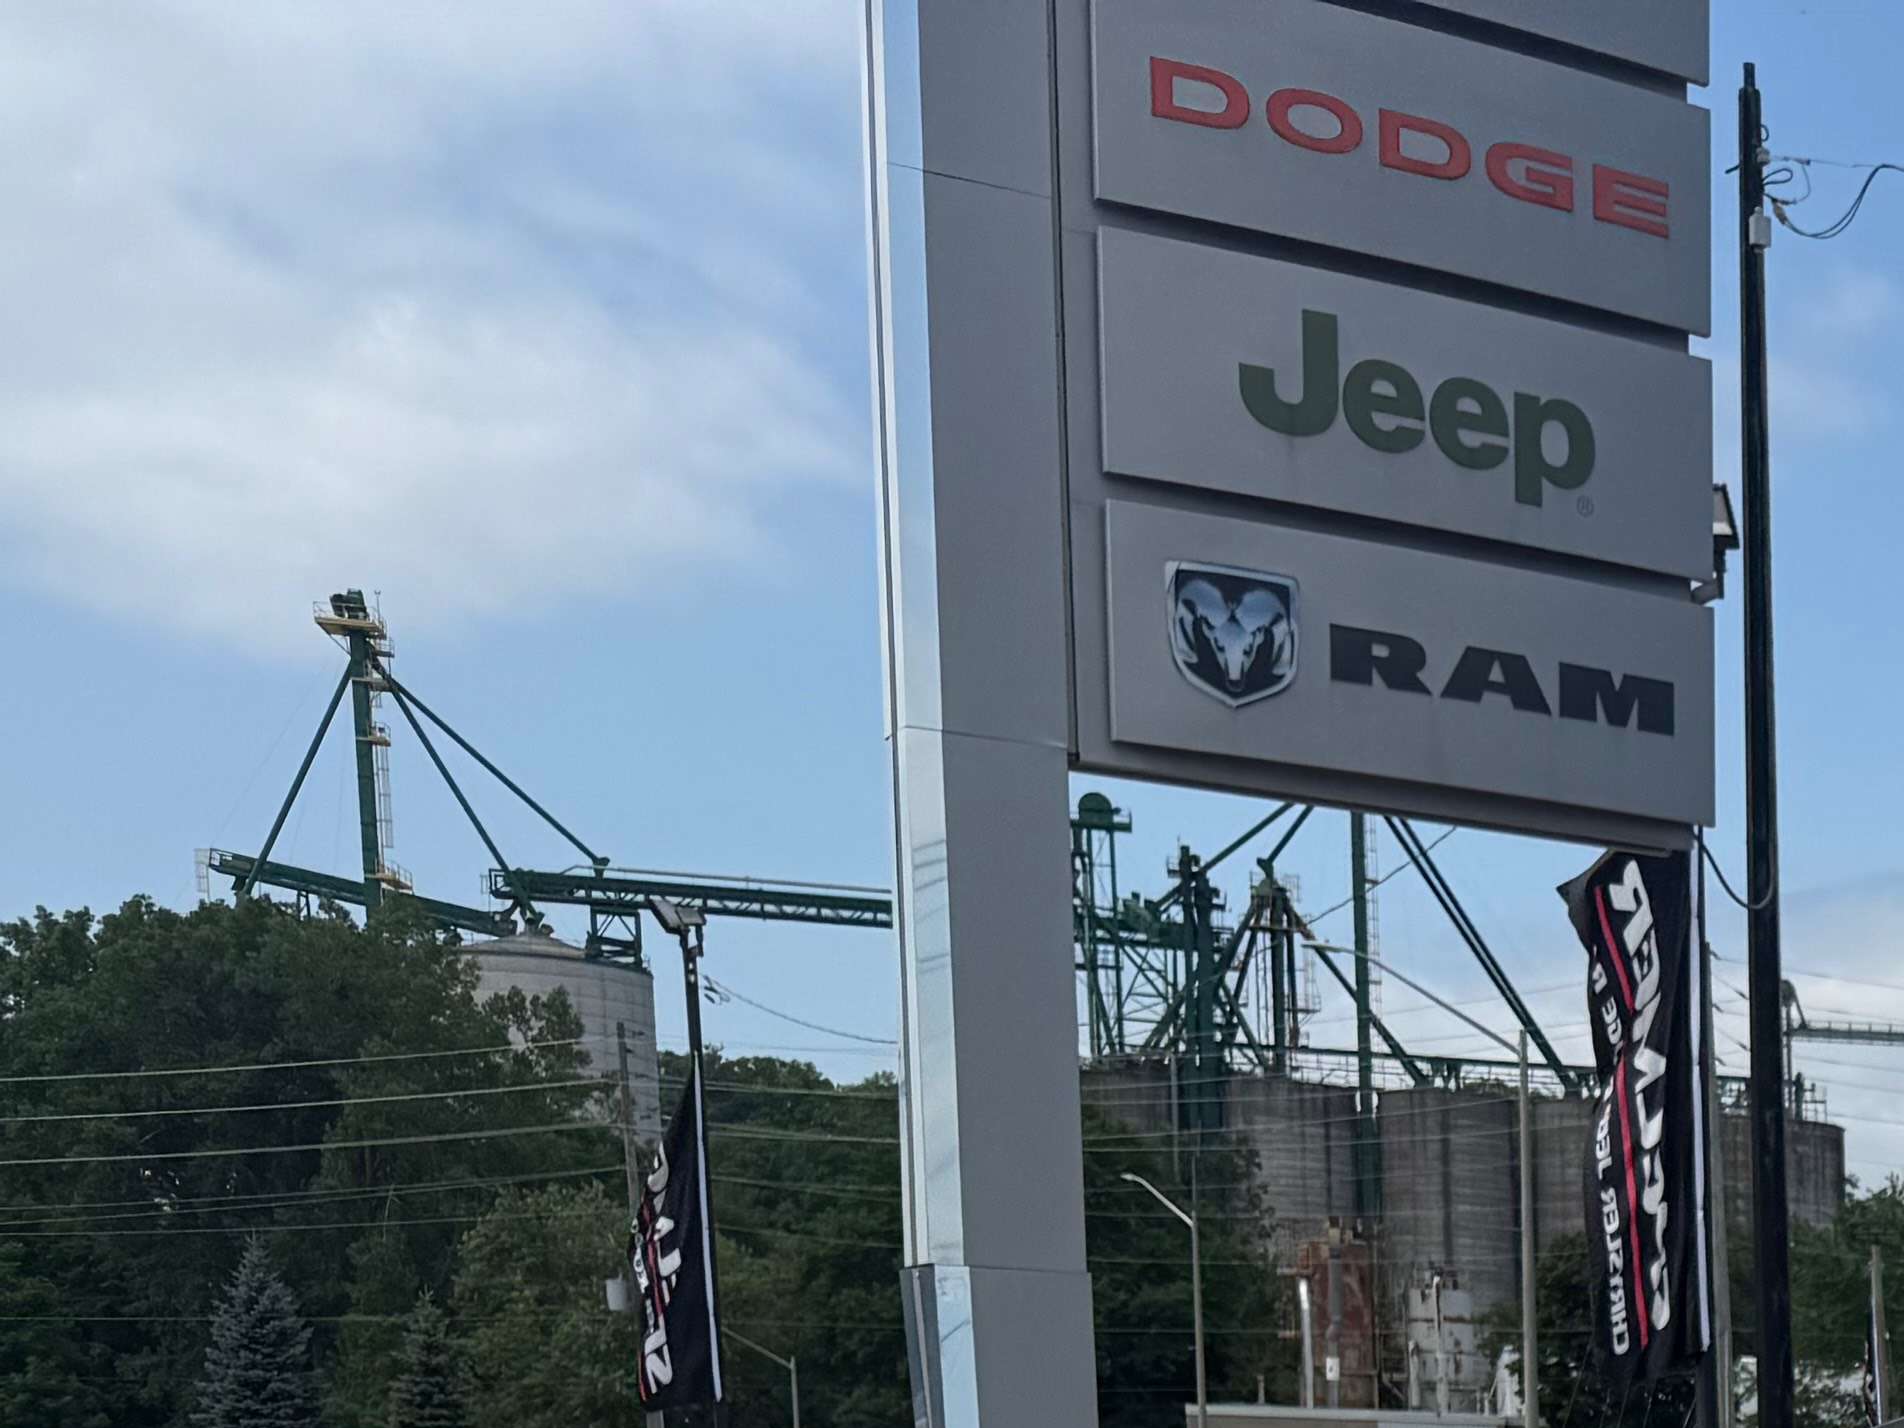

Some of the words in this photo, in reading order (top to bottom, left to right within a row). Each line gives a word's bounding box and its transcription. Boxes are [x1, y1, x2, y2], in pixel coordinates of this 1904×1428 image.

[1148, 55, 1671, 240] DODGE
[1238, 308, 1596, 506] Jeep
[1328, 624, 1675, 738] RAM
